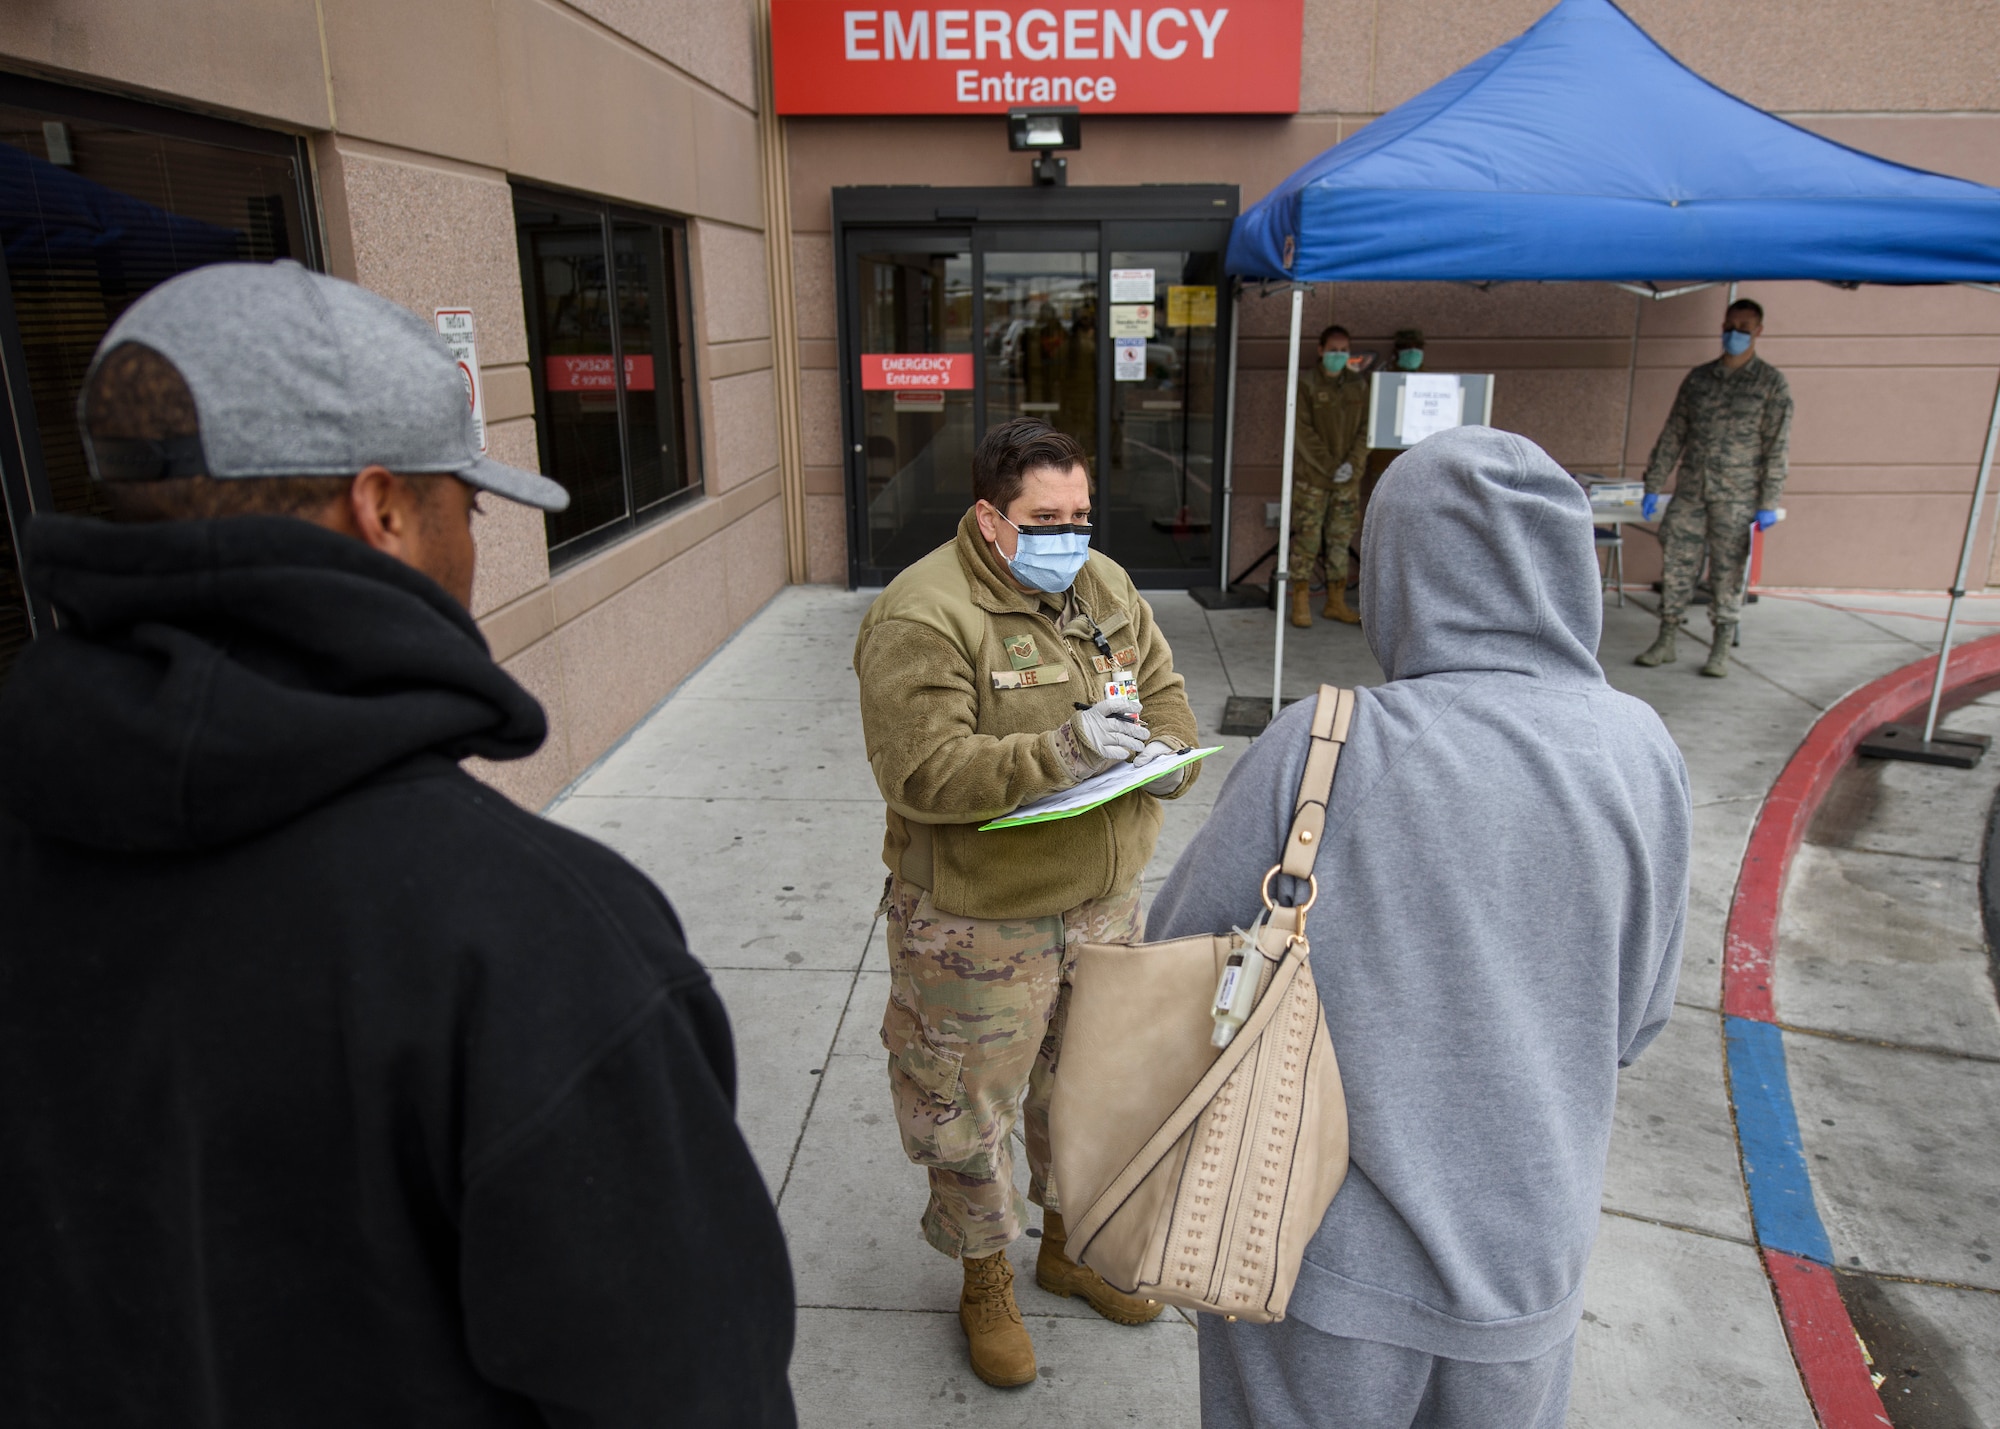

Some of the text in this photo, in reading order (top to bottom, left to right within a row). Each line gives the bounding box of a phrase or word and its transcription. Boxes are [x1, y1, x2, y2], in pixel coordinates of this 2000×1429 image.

[843, 8, 1229, 61] EMERGENCY
[956, 70, 1117, 103] Entrance
[882, 358, 953, 371] EMERGENCY
[886, 372, 950, 385] Entrance 5
[1019, 670, 1038, 686] LEE
